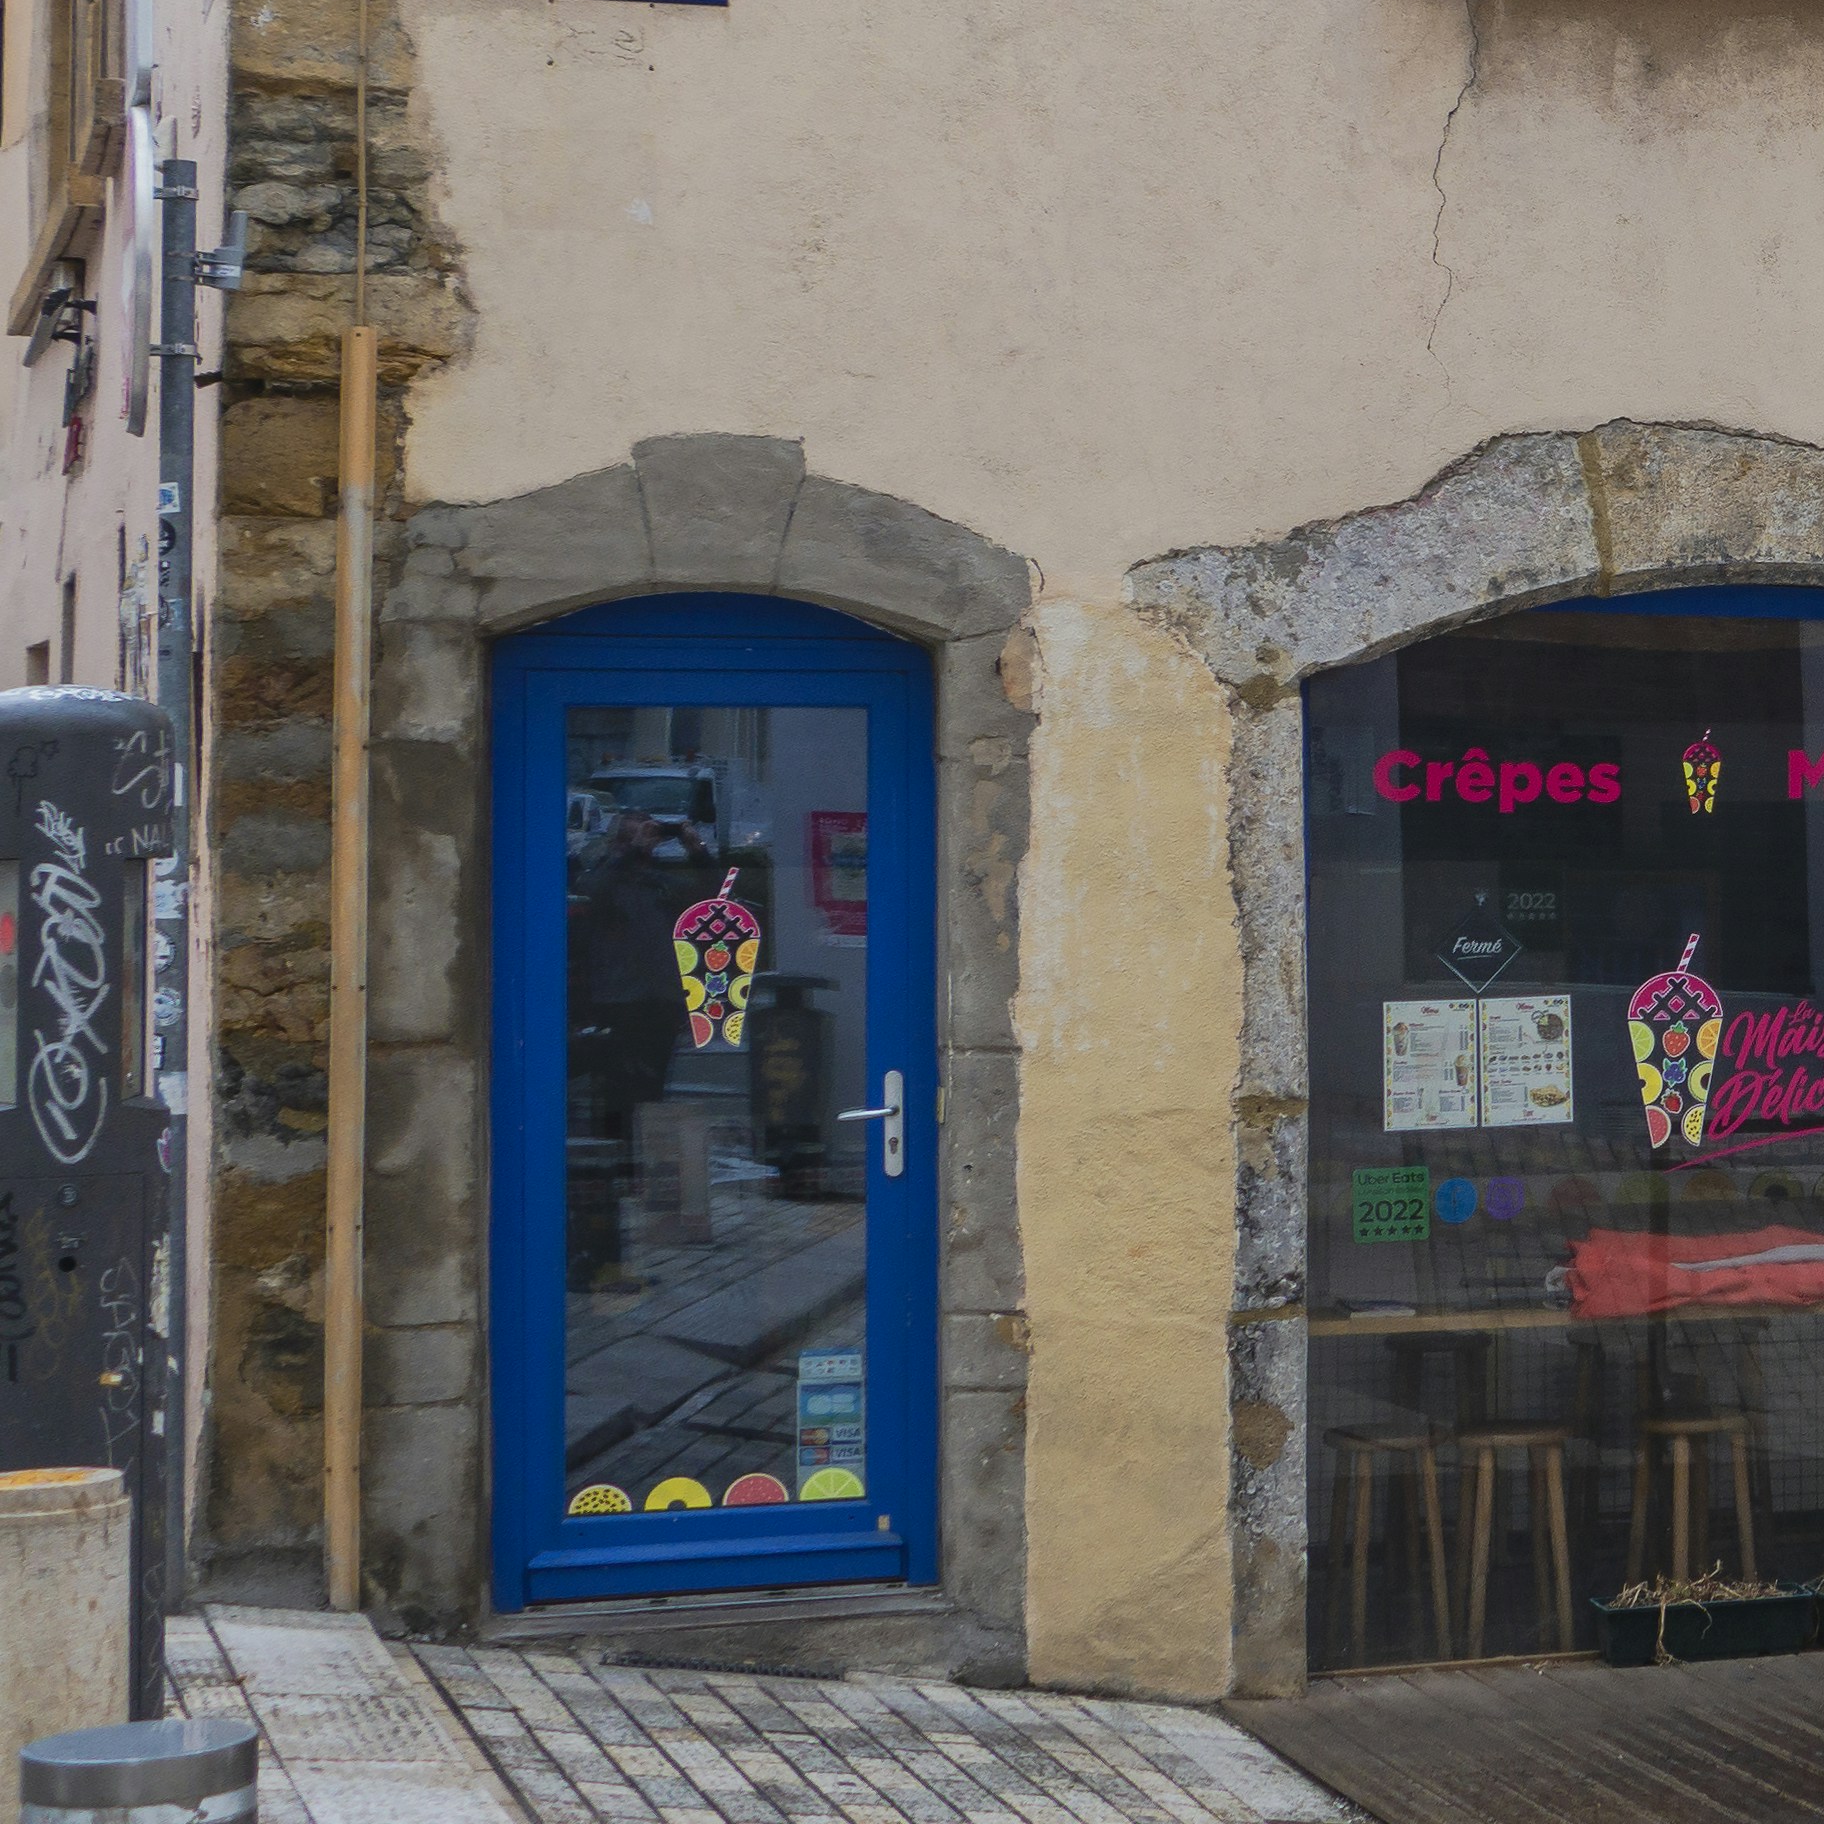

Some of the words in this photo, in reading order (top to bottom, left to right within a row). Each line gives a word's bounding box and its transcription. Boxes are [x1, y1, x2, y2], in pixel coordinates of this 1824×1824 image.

[1373, 746, 1622, 813] Crêpes
[1507, 892, 1557, 910] 2022
[1451, 936, 1503, 954] Fermé
[1357, 1174, 1389, 1186] Uber
[1392, 1172, 1425, 1184] Eats
[1358, 1198, 1425, 1223] 2022
